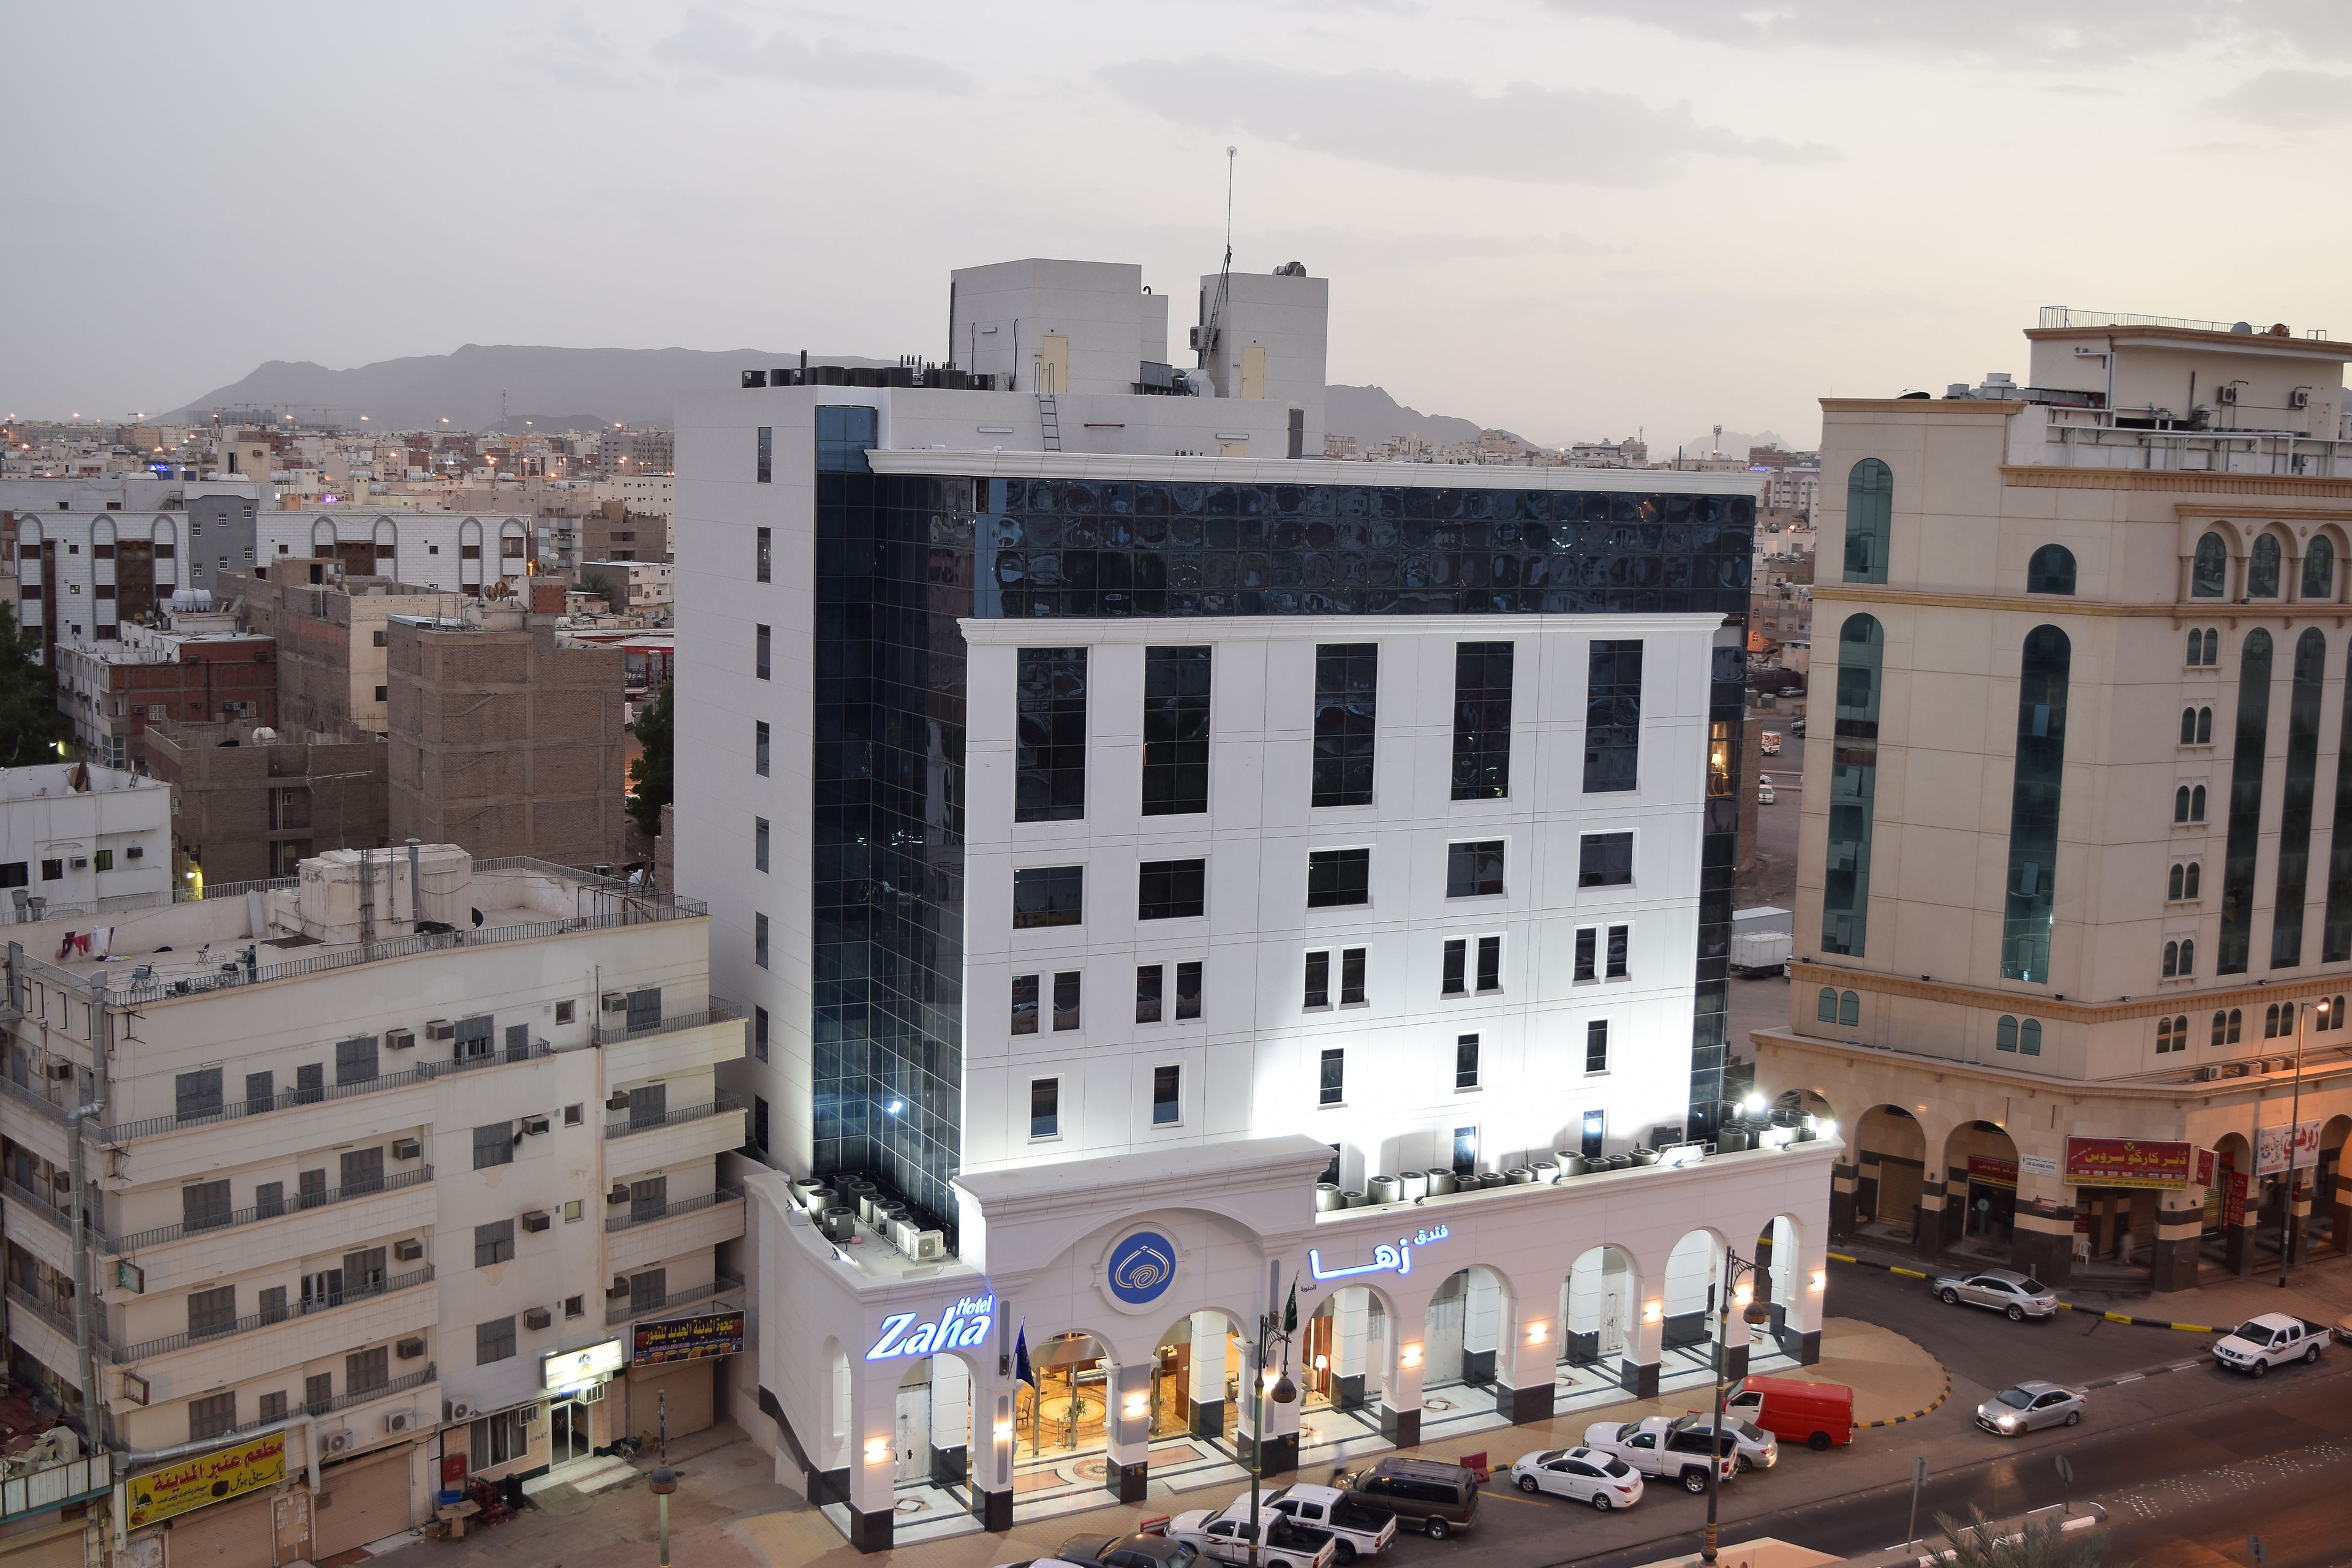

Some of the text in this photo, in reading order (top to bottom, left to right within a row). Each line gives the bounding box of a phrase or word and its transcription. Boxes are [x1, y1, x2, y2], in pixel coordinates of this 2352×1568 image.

[1414, 1224, 1449, 1245] فندق
[956, 1294, 992, 1315] Hotel
[645, 1325, 666, 1345] للتمور
[693, 1319, 715, 1339] المدينة
[716, 1318, 734, 1335] عجوة
[865, 1306, 992, 1360] Zaha
[152, 1441, 284, 1493] مطعم عنبر المدينة
